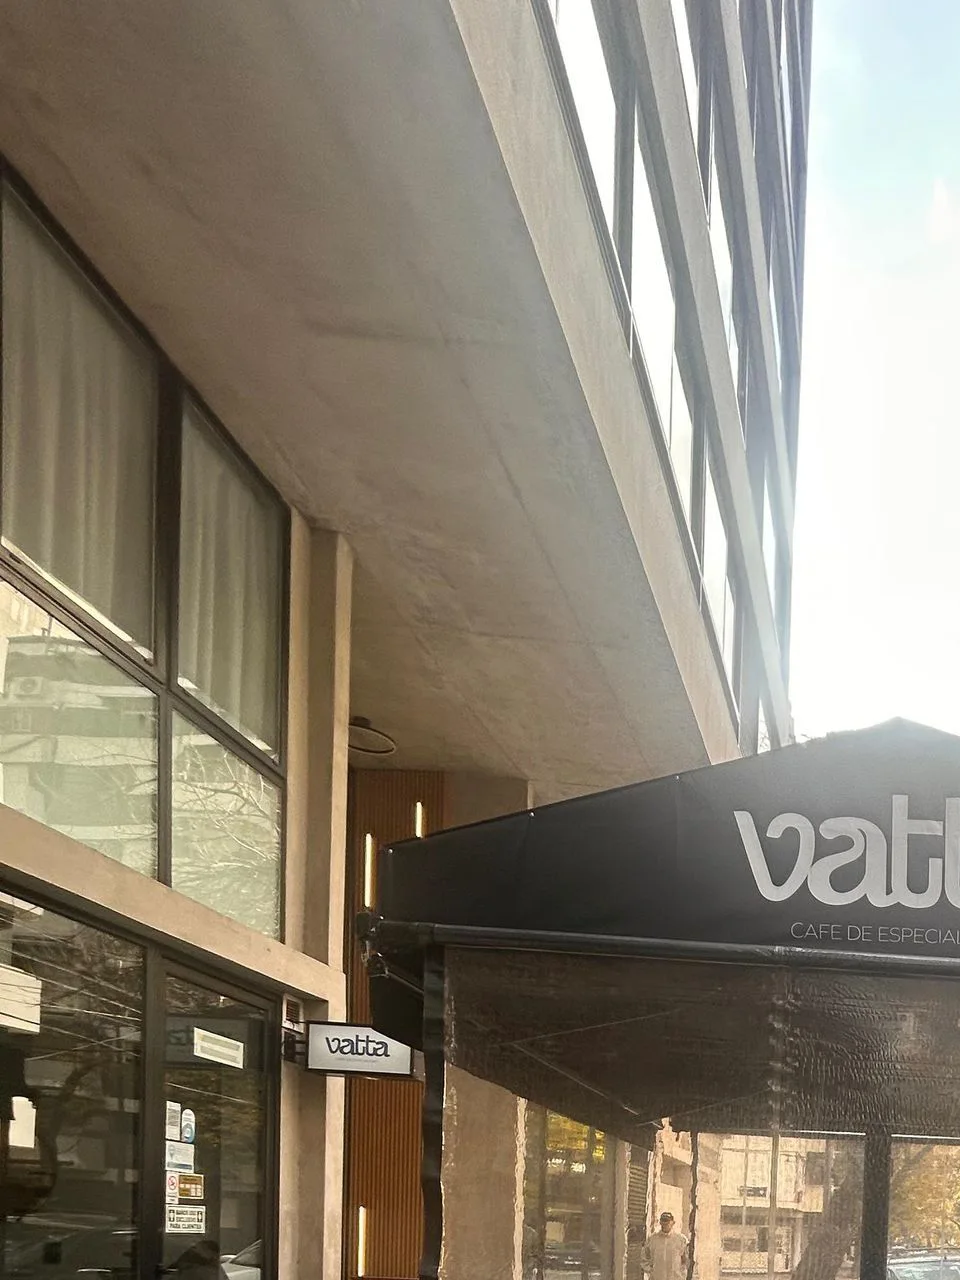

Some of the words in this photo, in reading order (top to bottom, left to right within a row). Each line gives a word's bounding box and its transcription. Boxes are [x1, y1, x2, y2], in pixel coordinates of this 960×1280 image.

[790, 922, 843, 941] CAFE
[847, 925, 873, 942] DE
[325, 1034, 391, 1058] vatta
